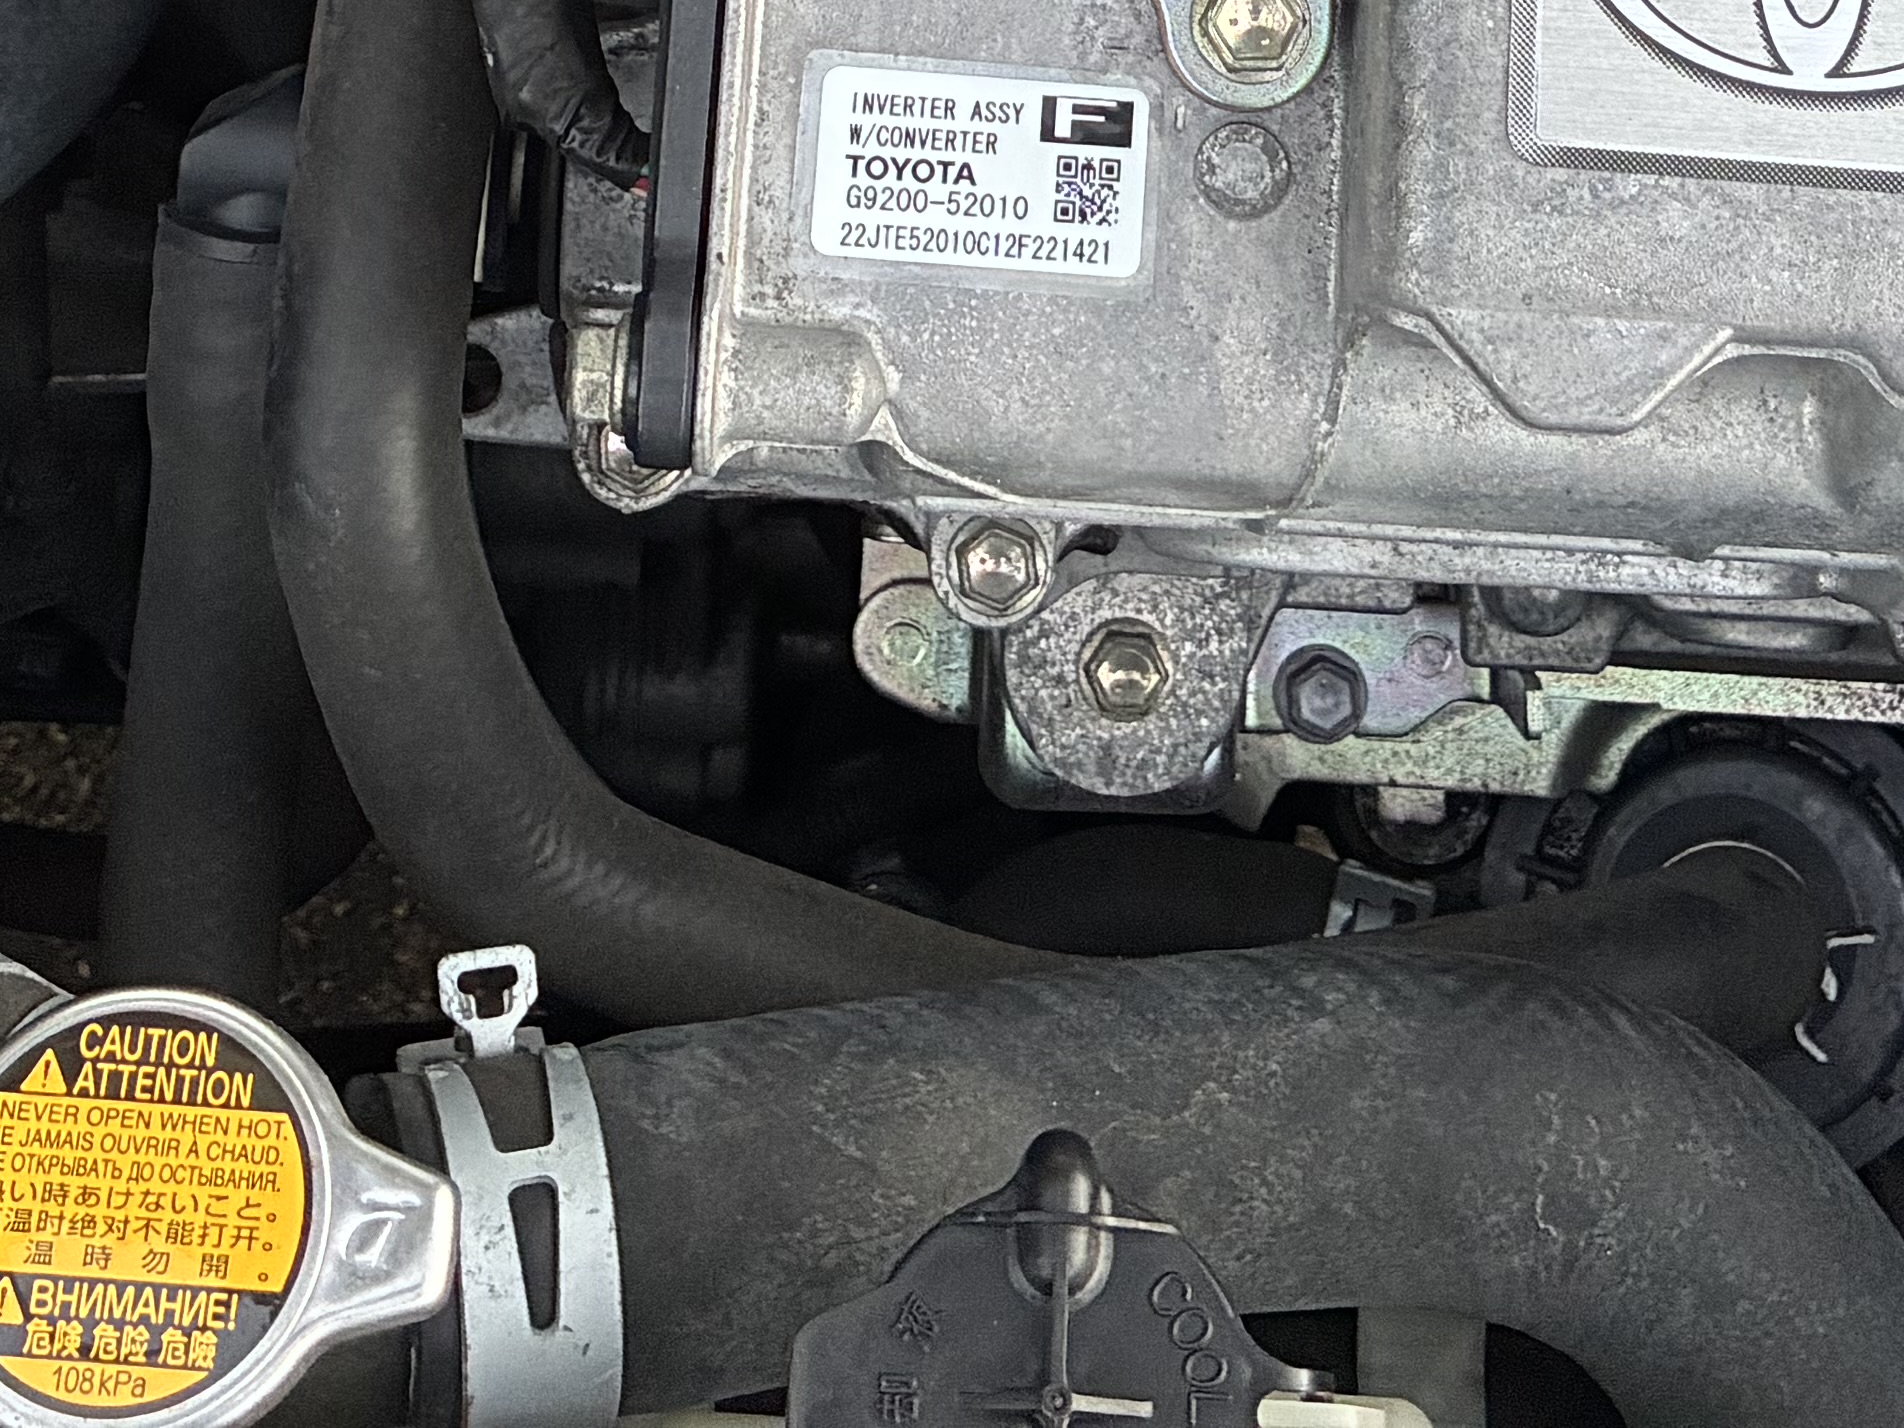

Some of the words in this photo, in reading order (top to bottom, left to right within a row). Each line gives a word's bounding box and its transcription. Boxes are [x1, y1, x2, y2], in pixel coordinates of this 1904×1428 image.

[852, 92, 956, 120] INVERTER
[970, 99, 1024, 124] ASSY
[1054, 97, 1117, 140] F
[850, 122, 997, 155] W/CONVERTER
[846, 154, 976, 186] TOYOTA
[846, 184, 1028, 220] G9200-52010
[840, 221, 1110, 264] 22JTE52010C12F221421
[79, 1022, 217, 1067] CAUTION
[72, 1061, 253, 1108] ATTENTION
[0, 1100, 79, 1124] NEVER
[86, 1106, 152, 1130] OPEN
[160, 1111, 229, 1136] WHEN
[237, 1117, 287, 1141] HOT.
[18, 1127, 94, 1152] JAMAIS
[101, 1133, 180, 1158] OUVRIR
[186, 1132, 199, 1159] À
[207, 1141, 284, 1166] CHAUD.
[10, 1153, 121, 1180] ОТКРЫВАТЬ
[126, 1161, 154, 1186] ДО
[160, 1164, 280, 1192] ОСТЫВАНИЯ.
[29, 1278, 239, 1329] ВНИМАНИЕ!
[23, 1317, 83, 1358] 危険
[90, 1322, 147, 1364] 危险
[158, 1326, 217, 1369] 危險
